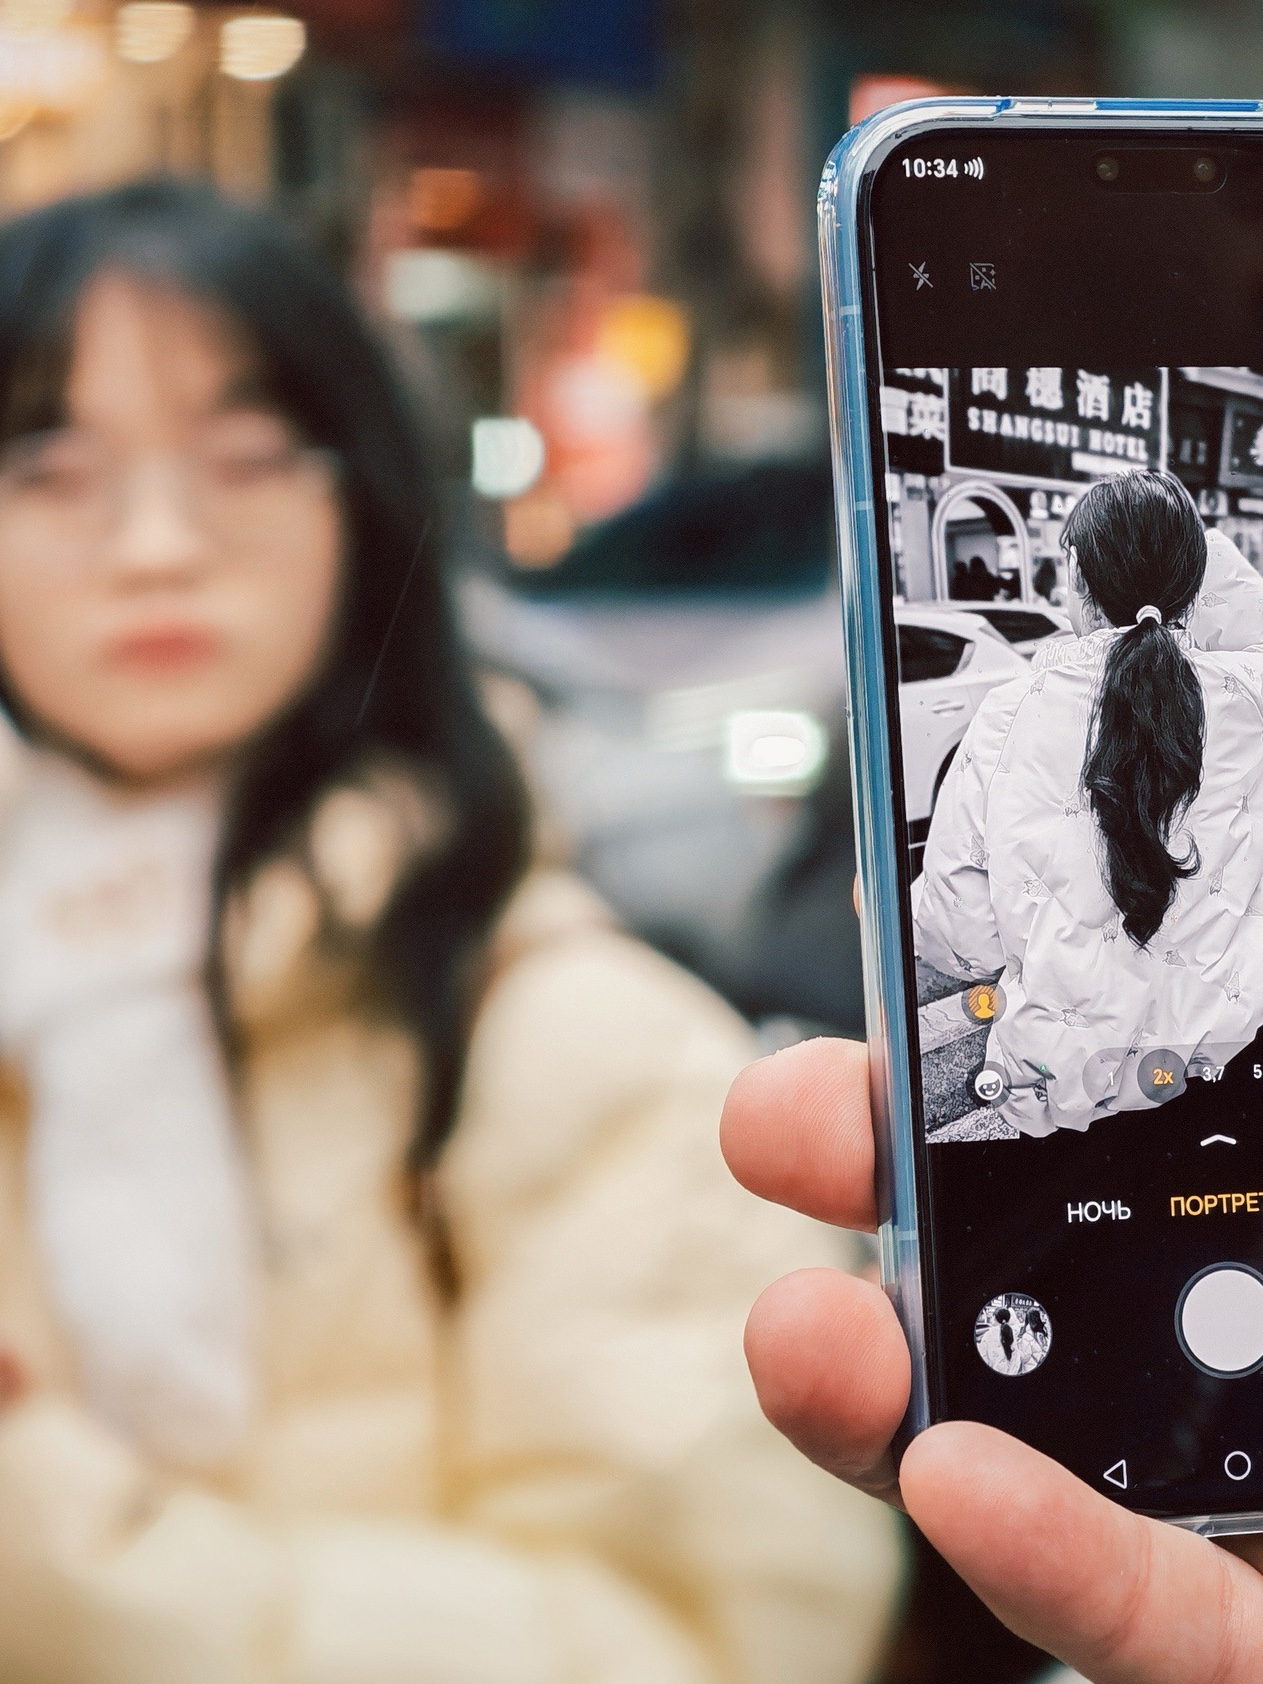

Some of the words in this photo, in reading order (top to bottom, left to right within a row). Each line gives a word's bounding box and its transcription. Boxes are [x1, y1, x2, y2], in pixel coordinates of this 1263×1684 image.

[902, 158, 959, 178] 10:34
[966, 406, 1080, 449] SHANGSUI
[1088, 428, 1149, 463] HOTEL
[1152, 1068, 1175, 1085] 2x
[1202, 1066, 1225, 1083] 3,7
[1067, 1200, 1132, 1223] НОЧЬ
